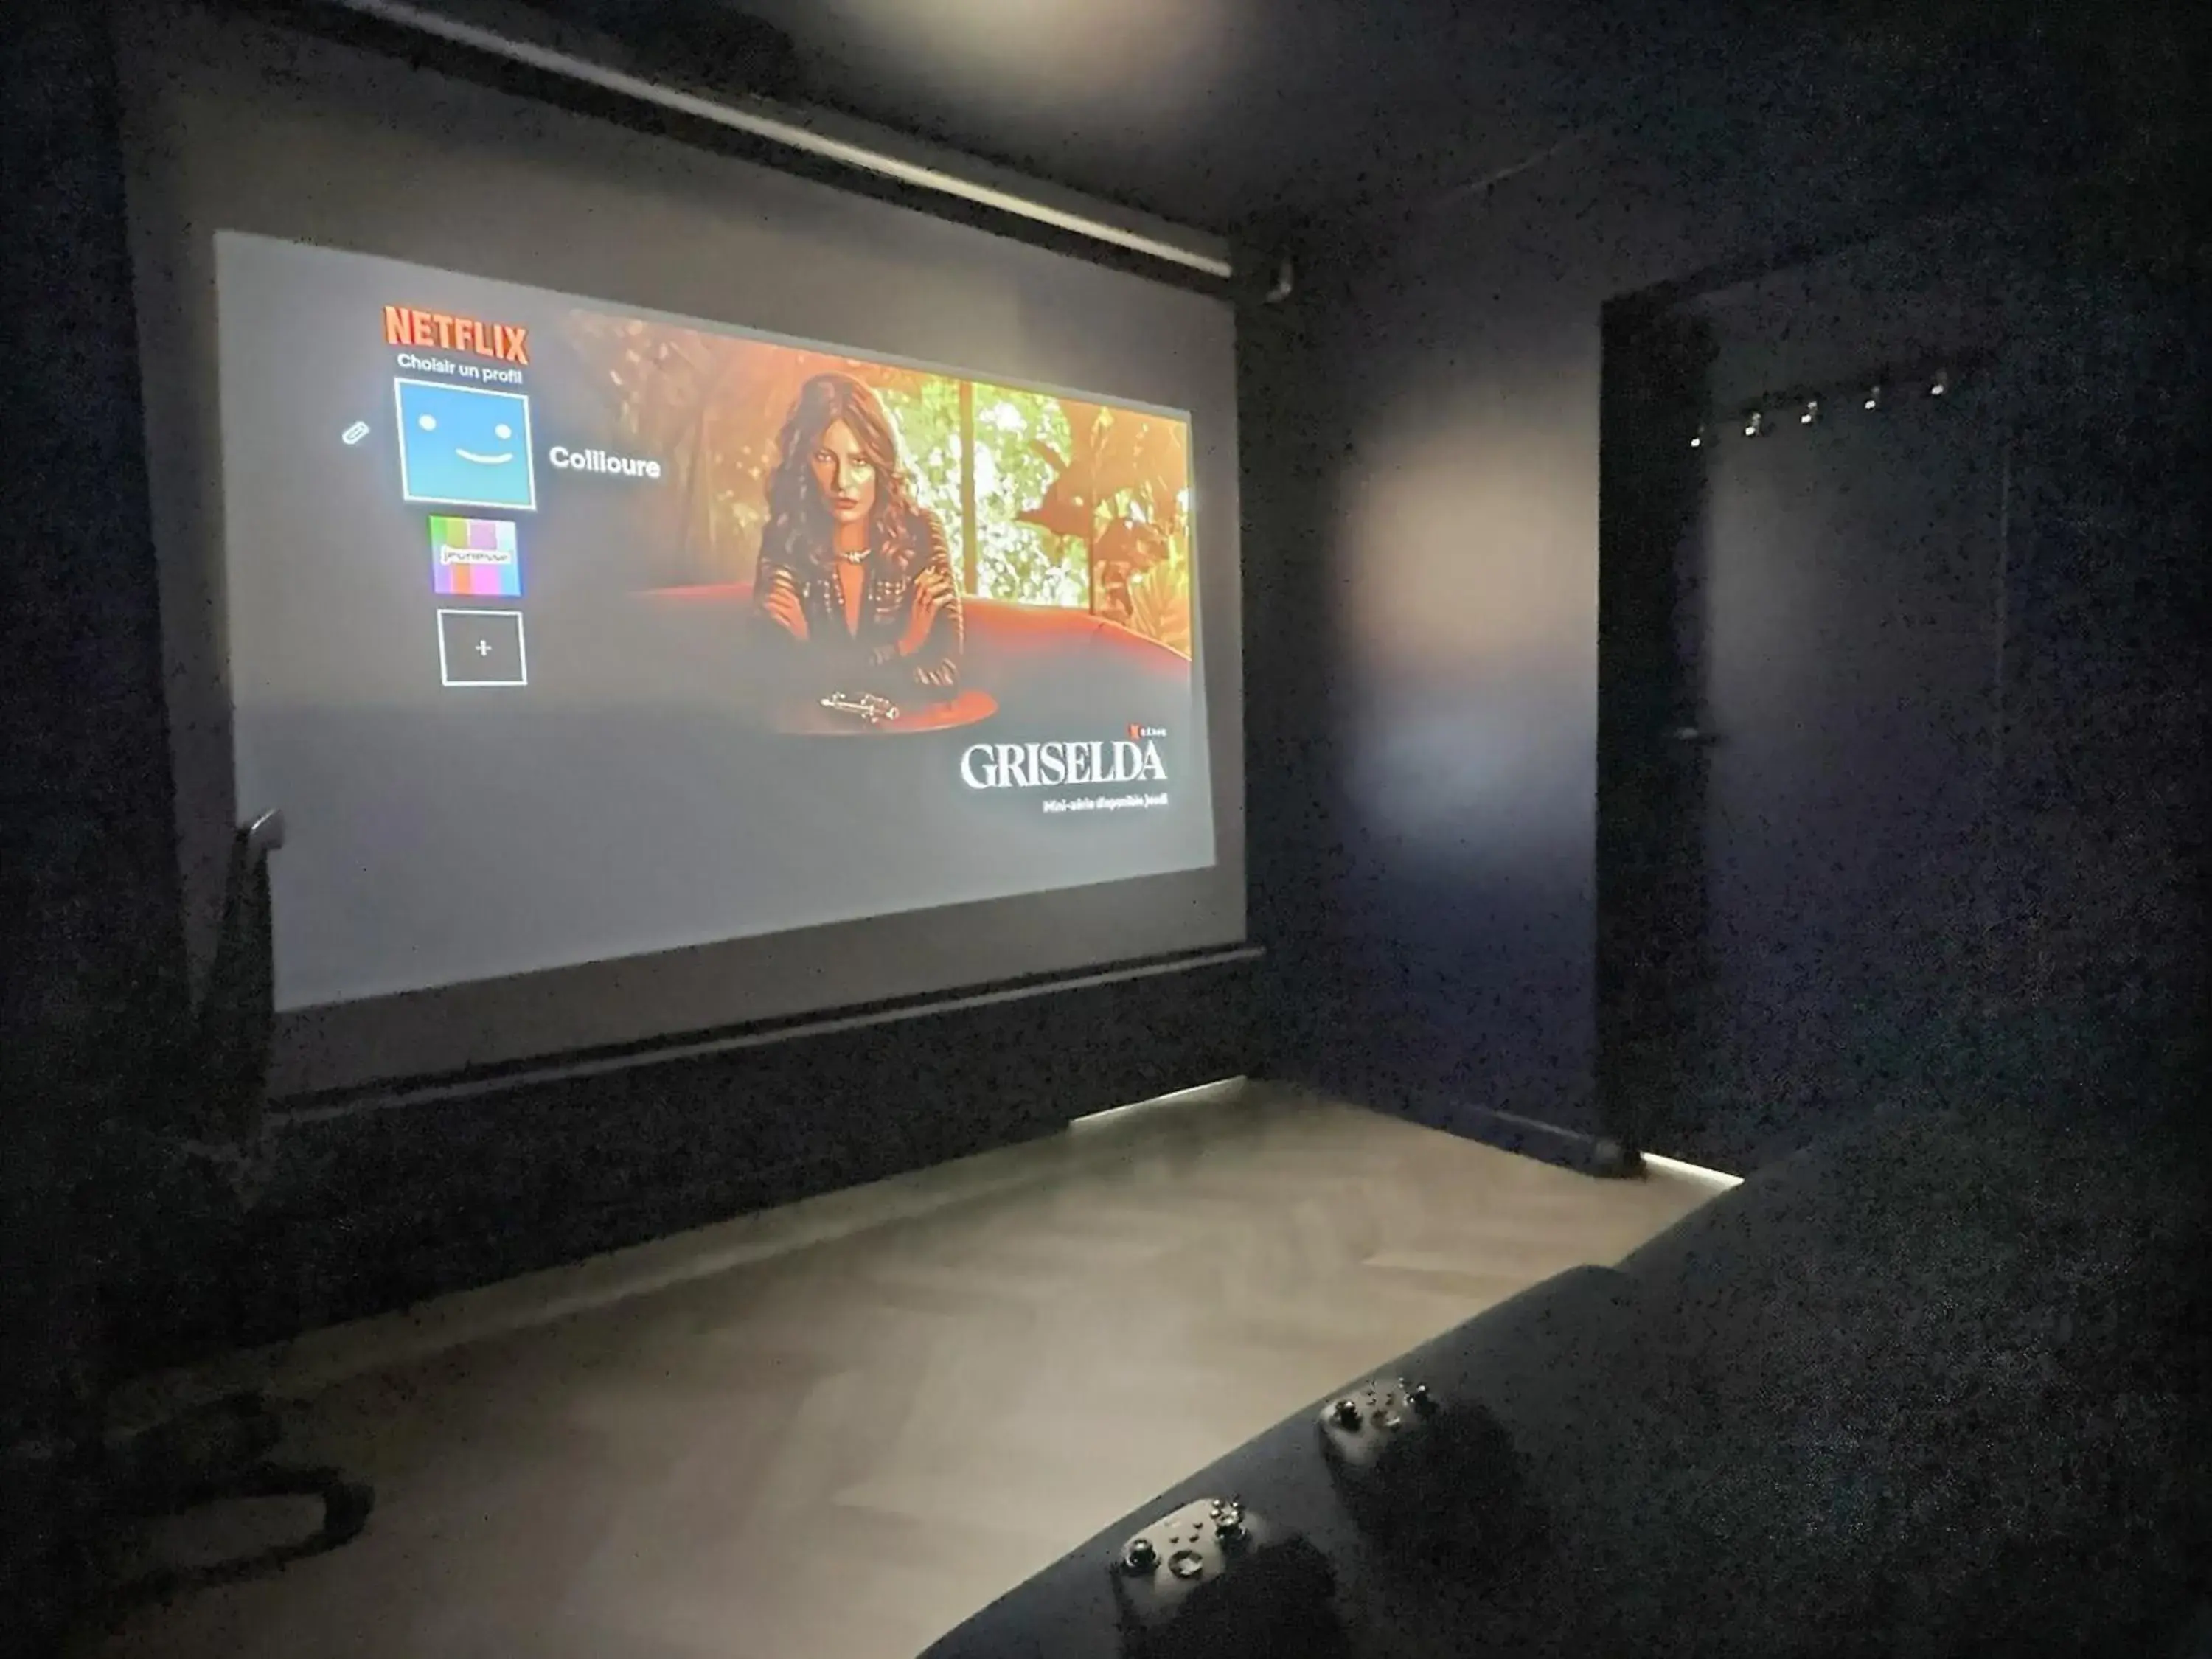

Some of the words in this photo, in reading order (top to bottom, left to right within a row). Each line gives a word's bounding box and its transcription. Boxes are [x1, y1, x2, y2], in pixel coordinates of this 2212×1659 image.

[383, 305, 529, 365] NETFLIX
[397, 353, 455, 375] Choisir
[459, 362, 479, 379] un
[482, 368, 524, 385] profil
[549, 445, 661, 479] Collioure
[960, 739, 1168, 789] GRISELDA
